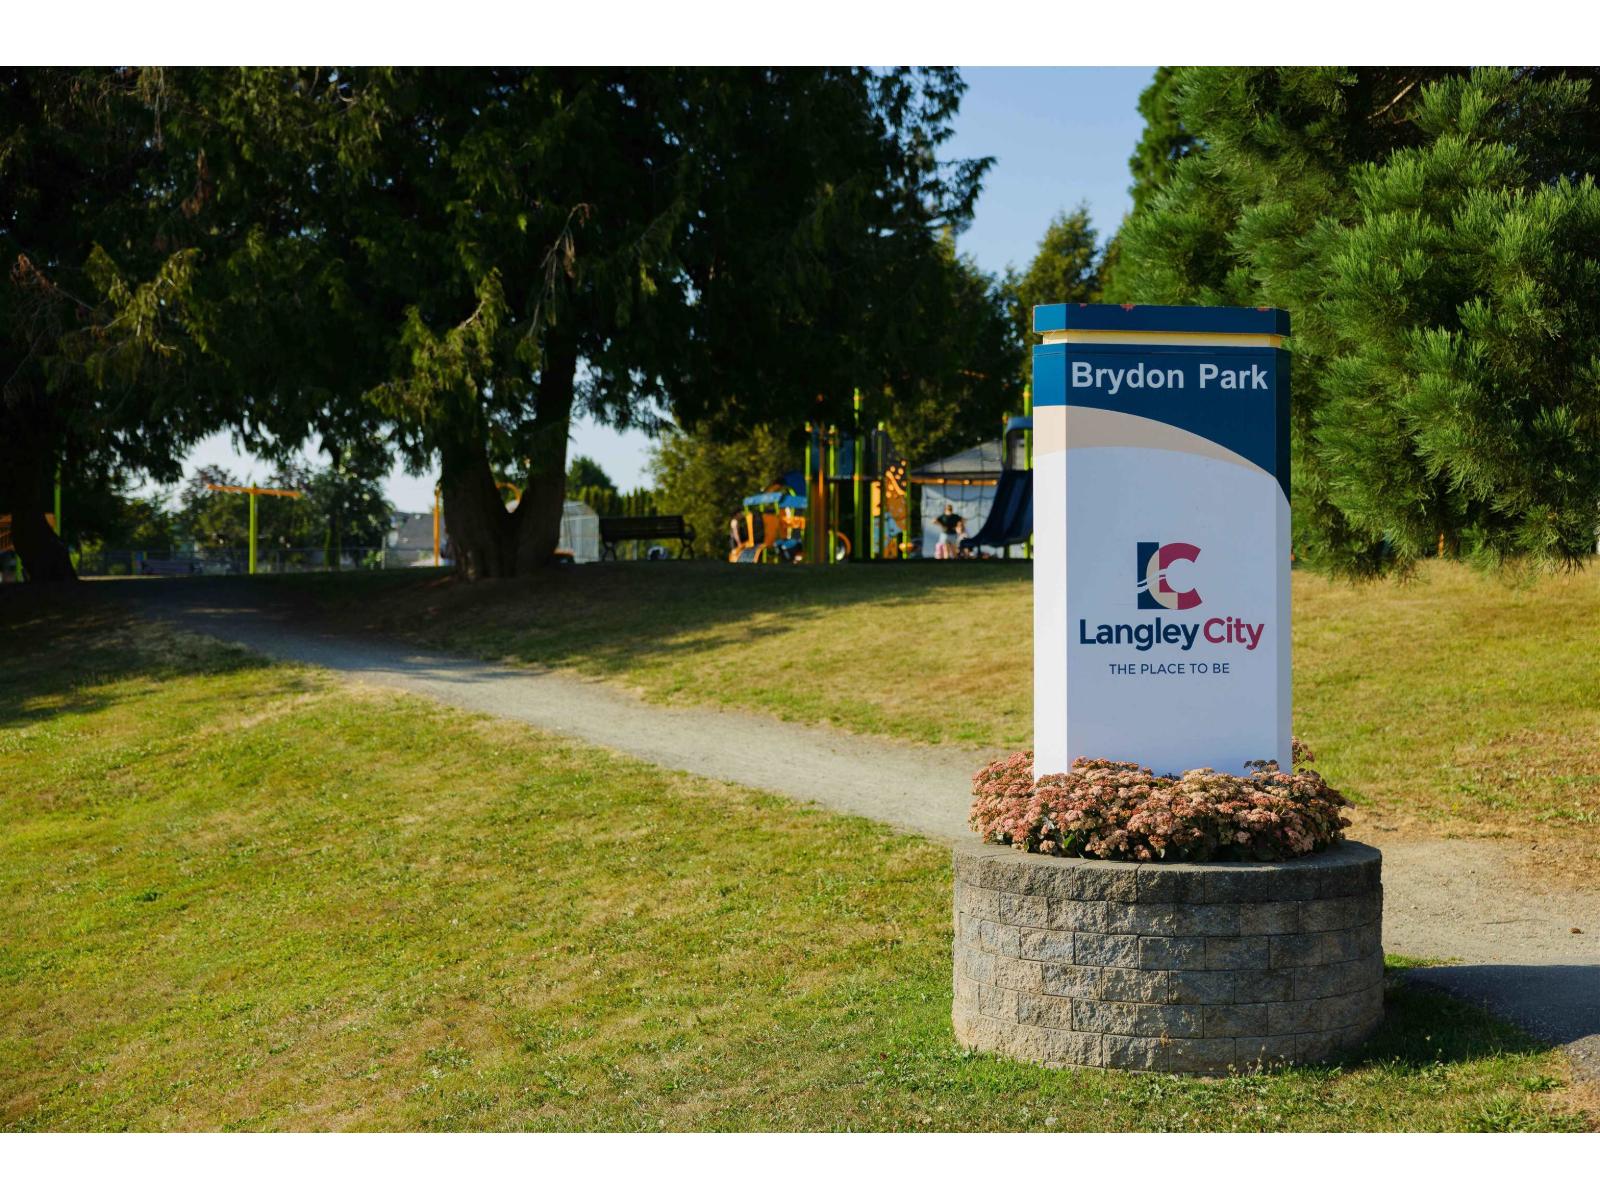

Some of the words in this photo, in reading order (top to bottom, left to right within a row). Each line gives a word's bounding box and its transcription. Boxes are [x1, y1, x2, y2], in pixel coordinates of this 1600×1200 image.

[1071, 361, 1185, 395] Brydon
[1199, 363, 1269, 390] Park
[1079, 616, 1200, 652] Langley
[1203, 616, 1265, 651] City
[1108, 663, 1136, 675] THE
[1140, 662, 1185, 675] PLACE
[1189, 662, 1208, 674] TO
[1212, 662, 1230, 674] BE
